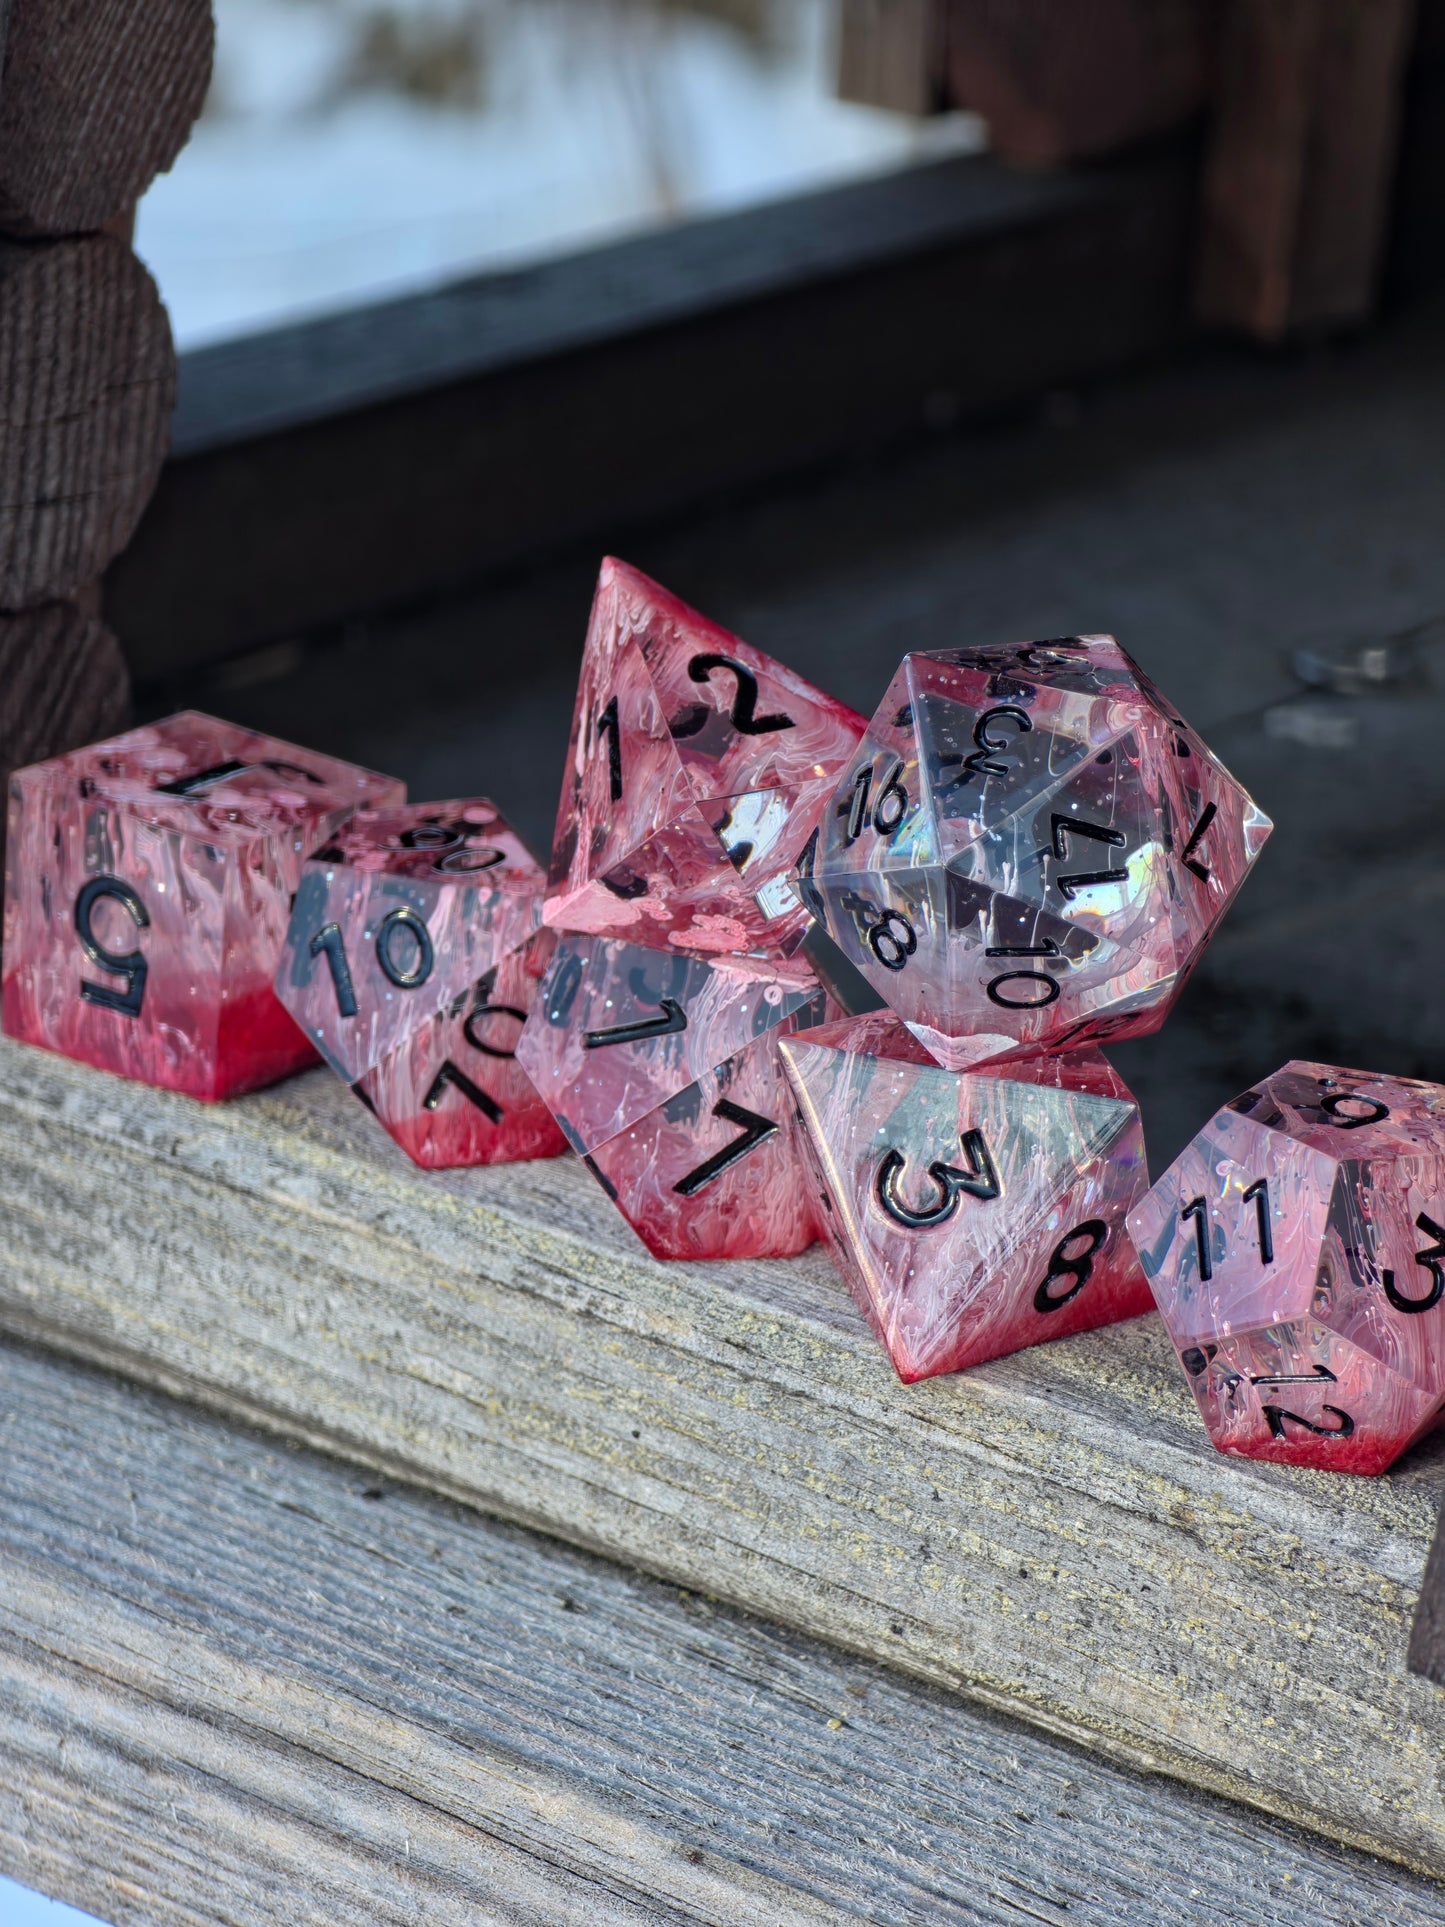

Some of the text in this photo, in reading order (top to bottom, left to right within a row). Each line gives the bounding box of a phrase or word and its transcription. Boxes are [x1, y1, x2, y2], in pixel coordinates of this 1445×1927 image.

[688, 653, 796, 735] 2
[961, 704, 1033, 777] 3
[597, 695, 623, 801] 1
[848, 761, 908, 839] 16
[75, 875, 150, 1018] 5
[309, 906, 434, 1019] 10
[867, 908, 918, 973] 8
[985, 936, 1061, 1010] 10
[877, 1127, 1001, 1228] 3
[1033, 1218, 1107, 1313] 8
[1181, 1178, 1275, 1283] 11
[1382, 1211, 1445, 1315] 3
[1250, 1364, 1356, 1441] 12
